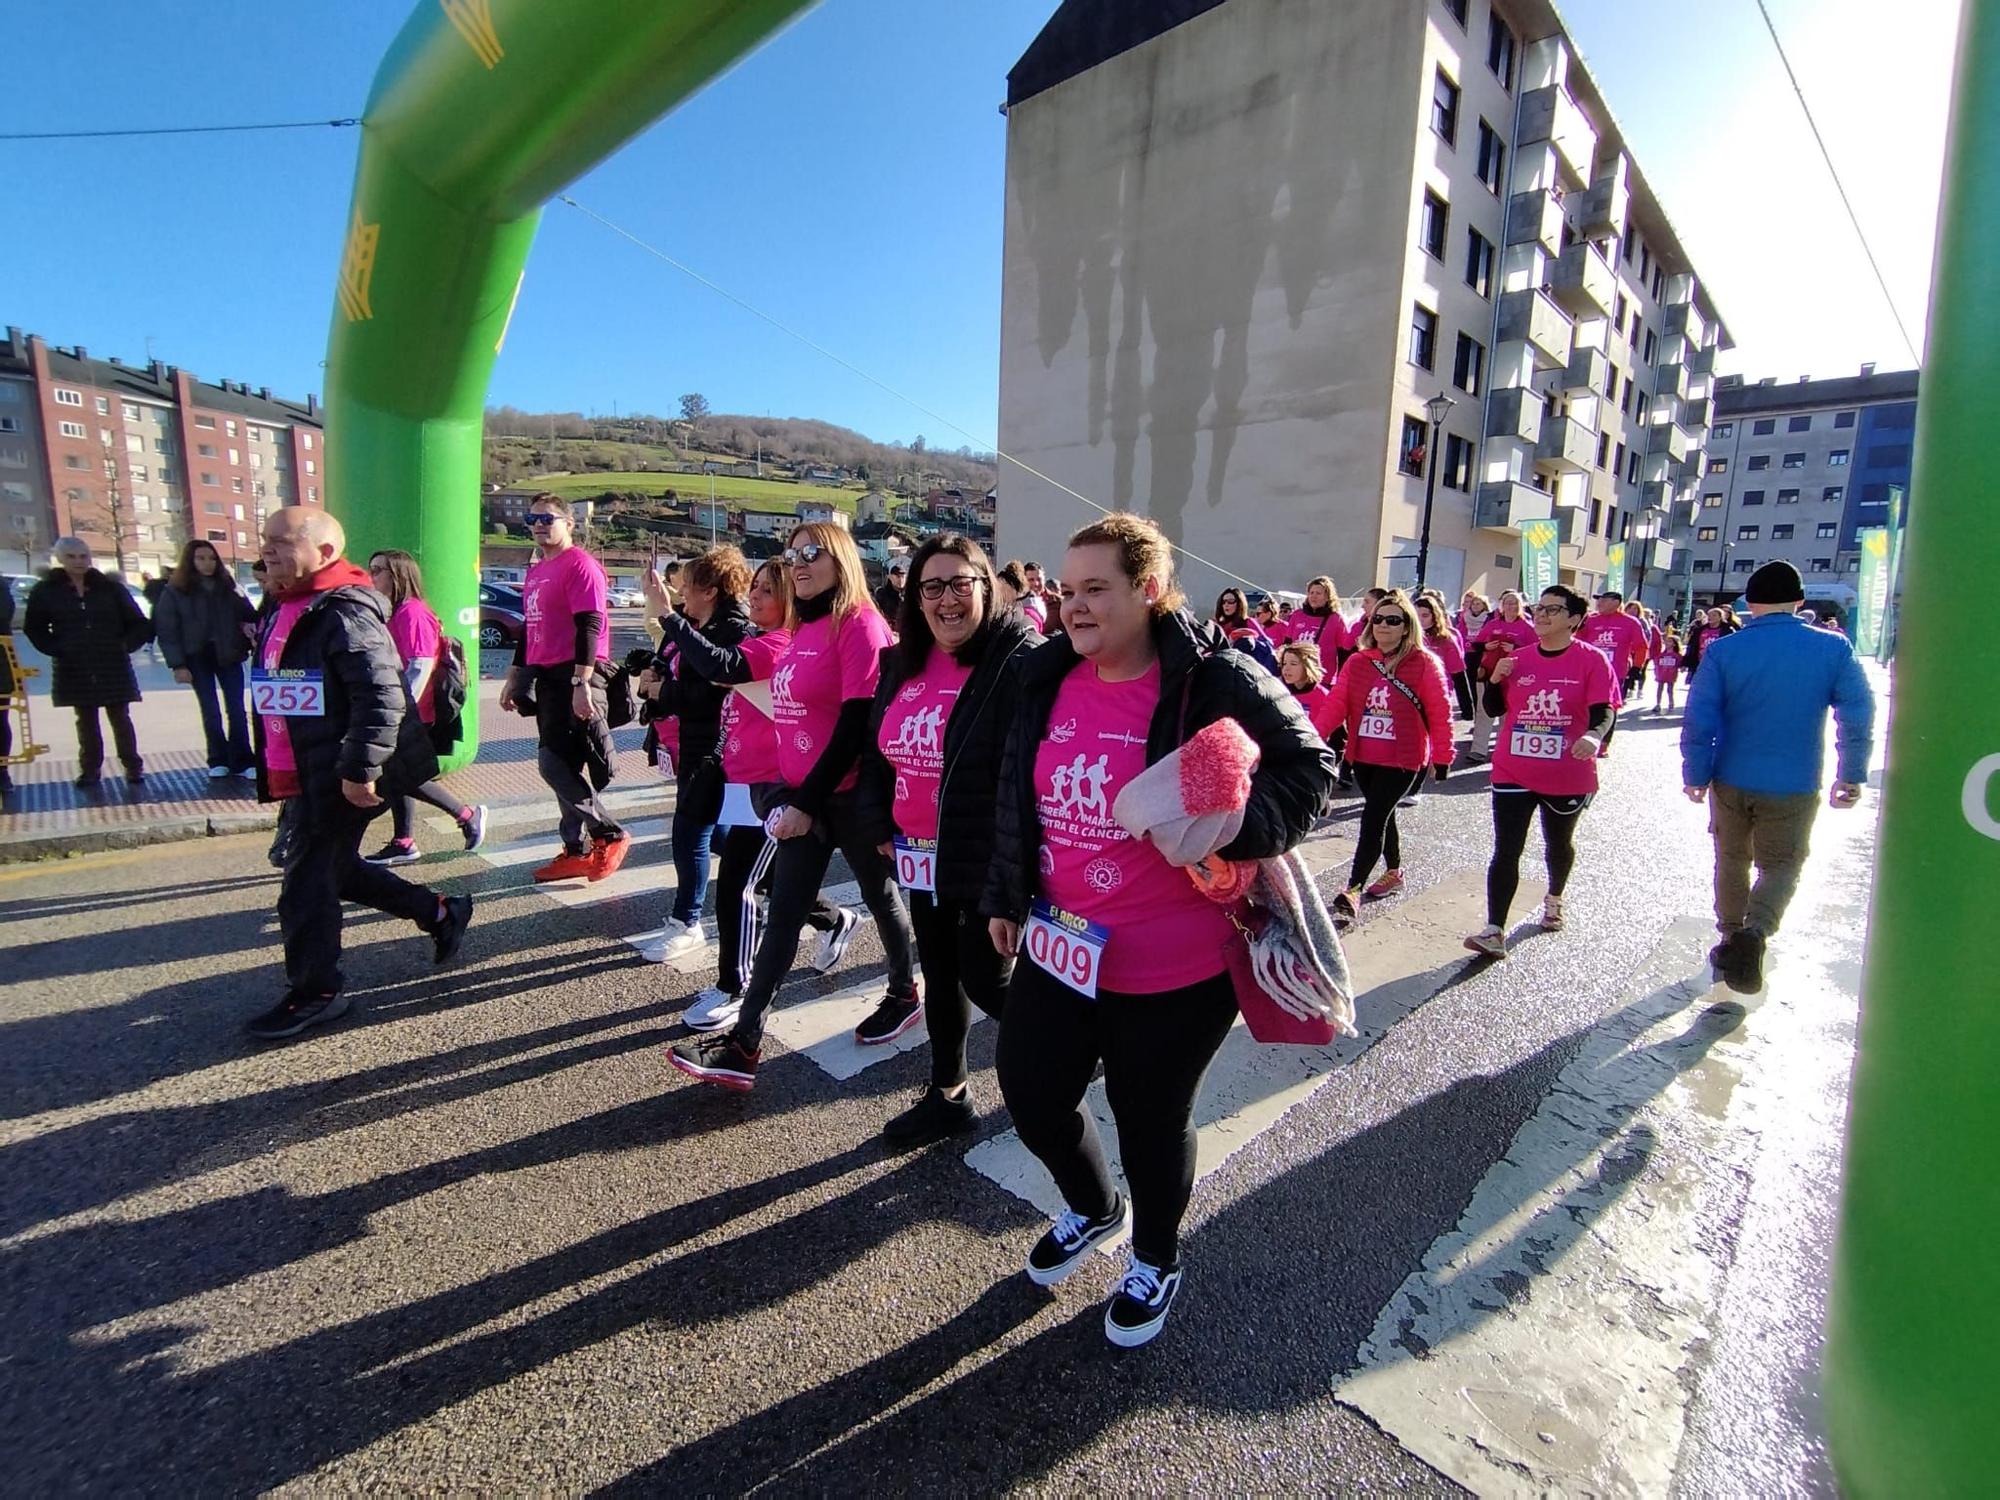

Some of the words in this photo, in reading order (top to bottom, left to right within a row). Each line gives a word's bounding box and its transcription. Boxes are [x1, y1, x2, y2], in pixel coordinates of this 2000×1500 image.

[257, 685, 319, 711] 252
[1362, 717, 1394, 736] 194
[1516, 735, 1558, 755] 193
[923, 758, 945, 769] CÁNC
[1068, 823, 1079, 835] EL
[1081, 825, 1129, 840] CÁNCER
[901, 855, 932, 886] 01
[1050, 904, 1059, 917] EL
[1060, 909, 1089, 931] ARCO
[1031, 925, 1092, 986] 009
